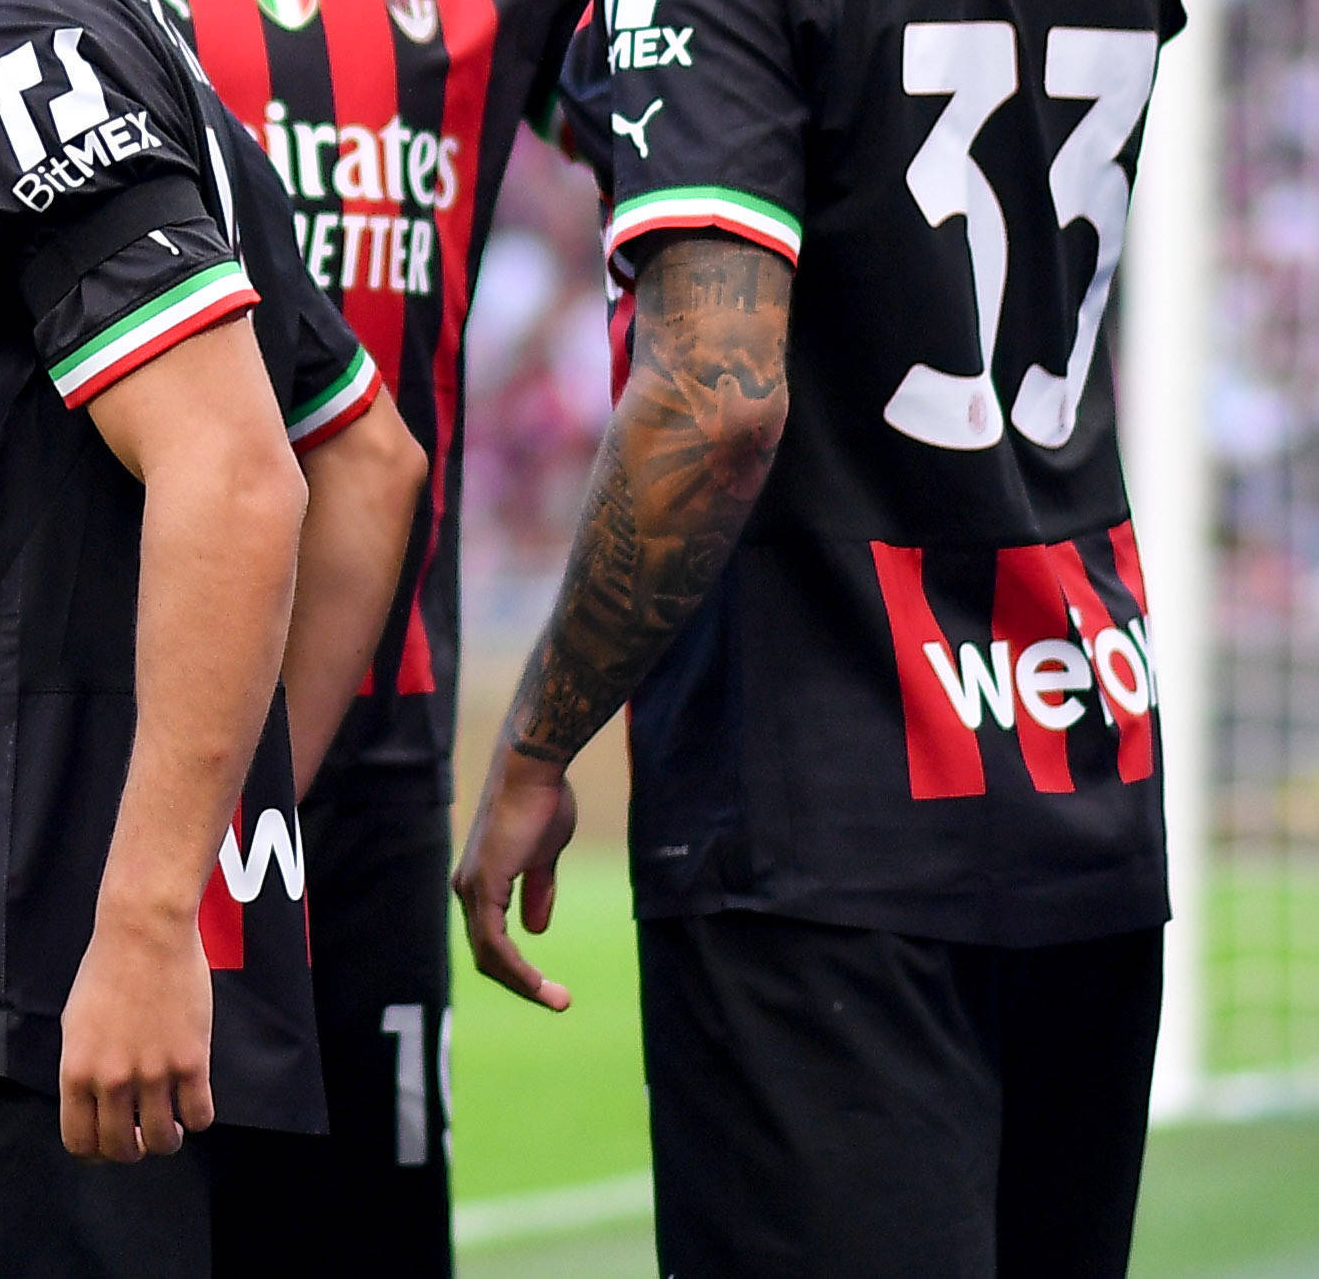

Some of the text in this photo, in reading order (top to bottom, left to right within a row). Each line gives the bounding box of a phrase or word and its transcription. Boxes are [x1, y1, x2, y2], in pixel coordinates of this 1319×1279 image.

[12, 110, 163, 213] BitMEX
[244, 100, 460, 211] irates
[883, 22, 1160, 451] 33
